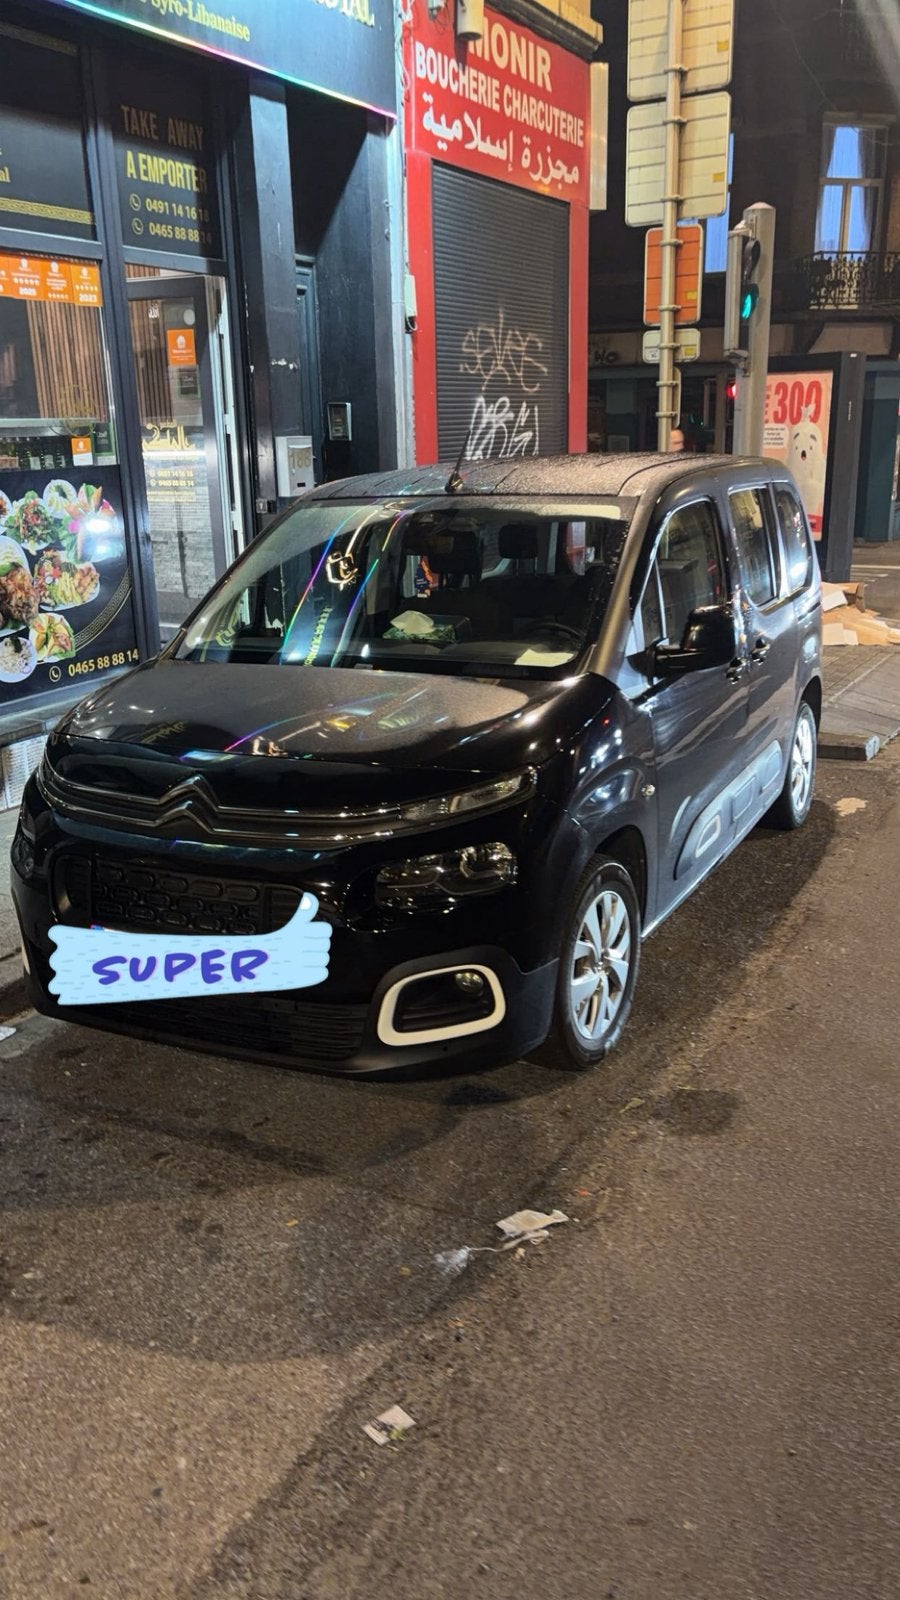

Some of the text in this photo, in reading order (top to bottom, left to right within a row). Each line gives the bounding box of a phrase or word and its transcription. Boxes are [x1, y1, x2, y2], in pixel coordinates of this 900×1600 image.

[414, 41, 584, 148] BOUCHERIE CHARCUTERIE
[121, 105, 203, 151] TAKE AWAY
[422, 92, 579, 190] مجزرة إسلامية
[126, 150, 208, 194] A EMPORTER
[145, 198, 170, 215] 0491
[172, 203, 184, 218] 14
[185, 205, 198, 220] 16
[149, 222, 173, 238] 0465
[175, 227, 187, 241] 88
[188, 228, 200, 243] 88
[773, 380, 822, 425] 300
[68, 648, 139, 677] 0465 88 88 14
